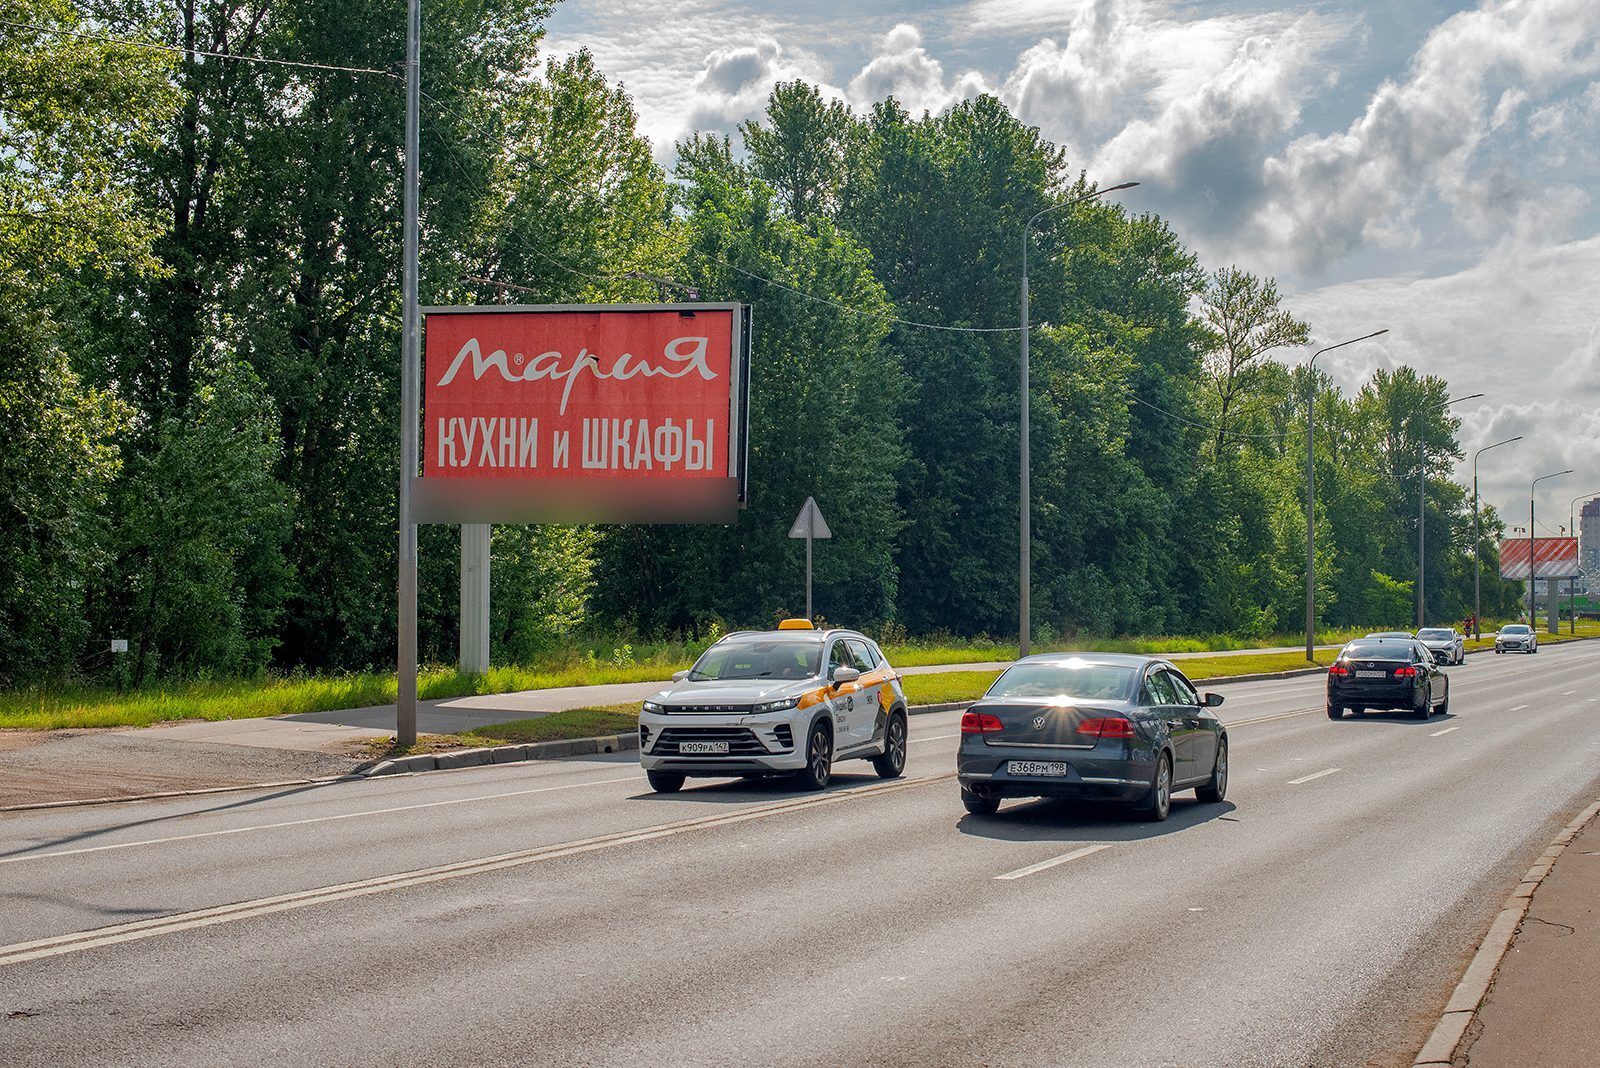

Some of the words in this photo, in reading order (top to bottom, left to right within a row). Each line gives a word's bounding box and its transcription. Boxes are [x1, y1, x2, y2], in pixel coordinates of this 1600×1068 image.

[437, 417, 539, 468] КУХНИ
[552, 430, 570, 469] и
[581, 417, 715, 471] ШКАФЫ
